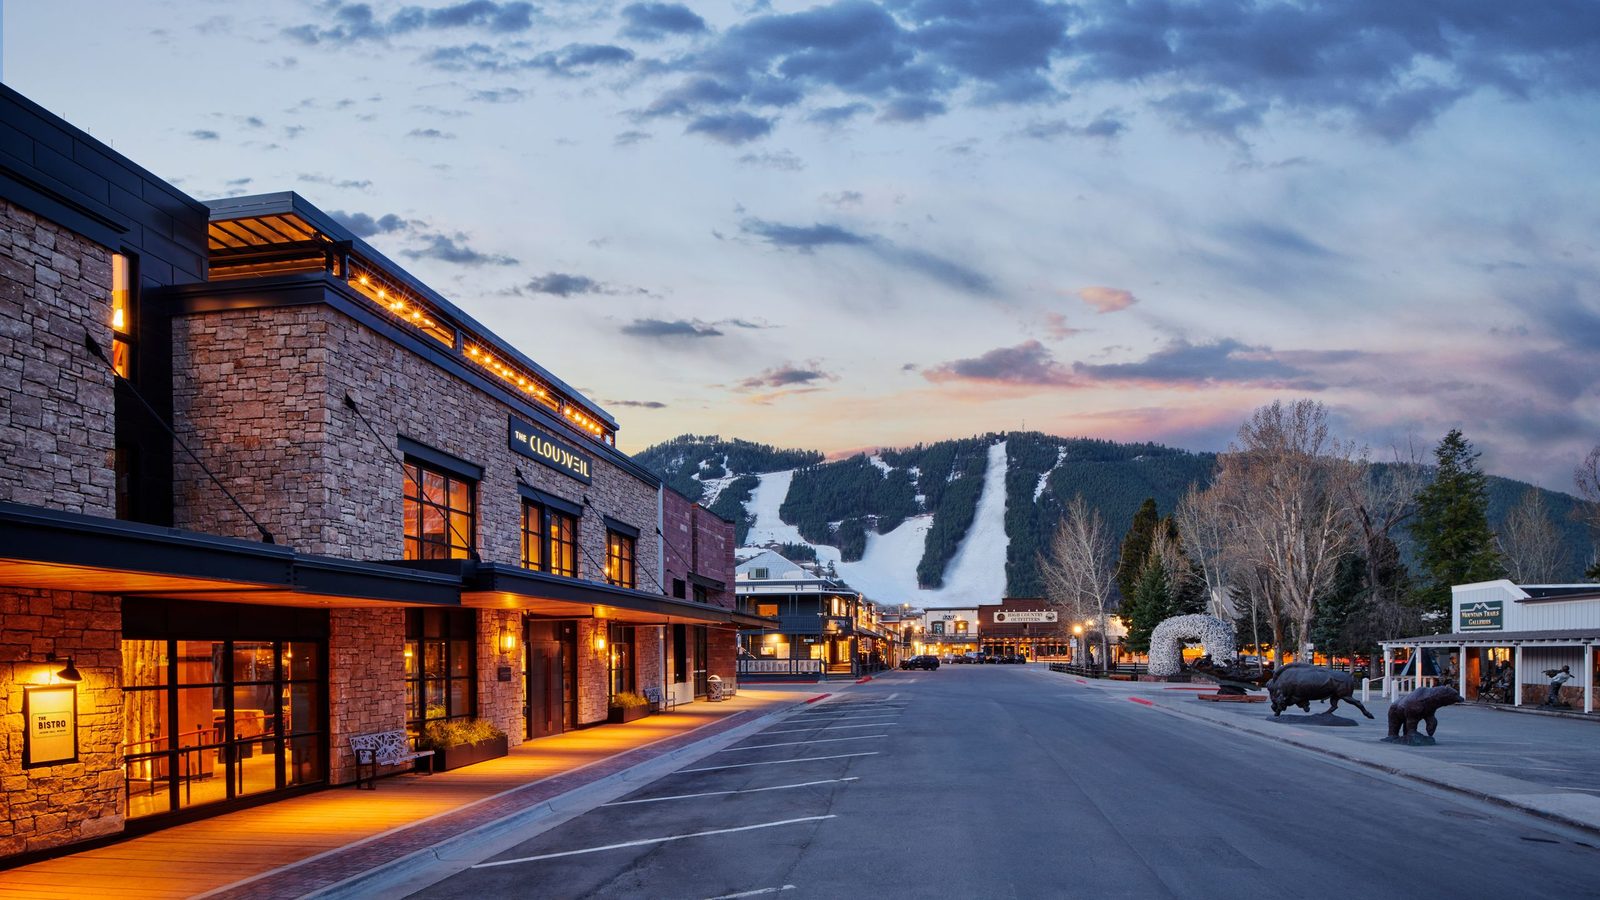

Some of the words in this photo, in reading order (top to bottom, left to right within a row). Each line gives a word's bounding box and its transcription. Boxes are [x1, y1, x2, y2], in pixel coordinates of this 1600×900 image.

[515, 431, 527, 443] THE
[530, 435, 590, 478] CLOUDVEIL
[38, 720, 66, 729] BISTRO
